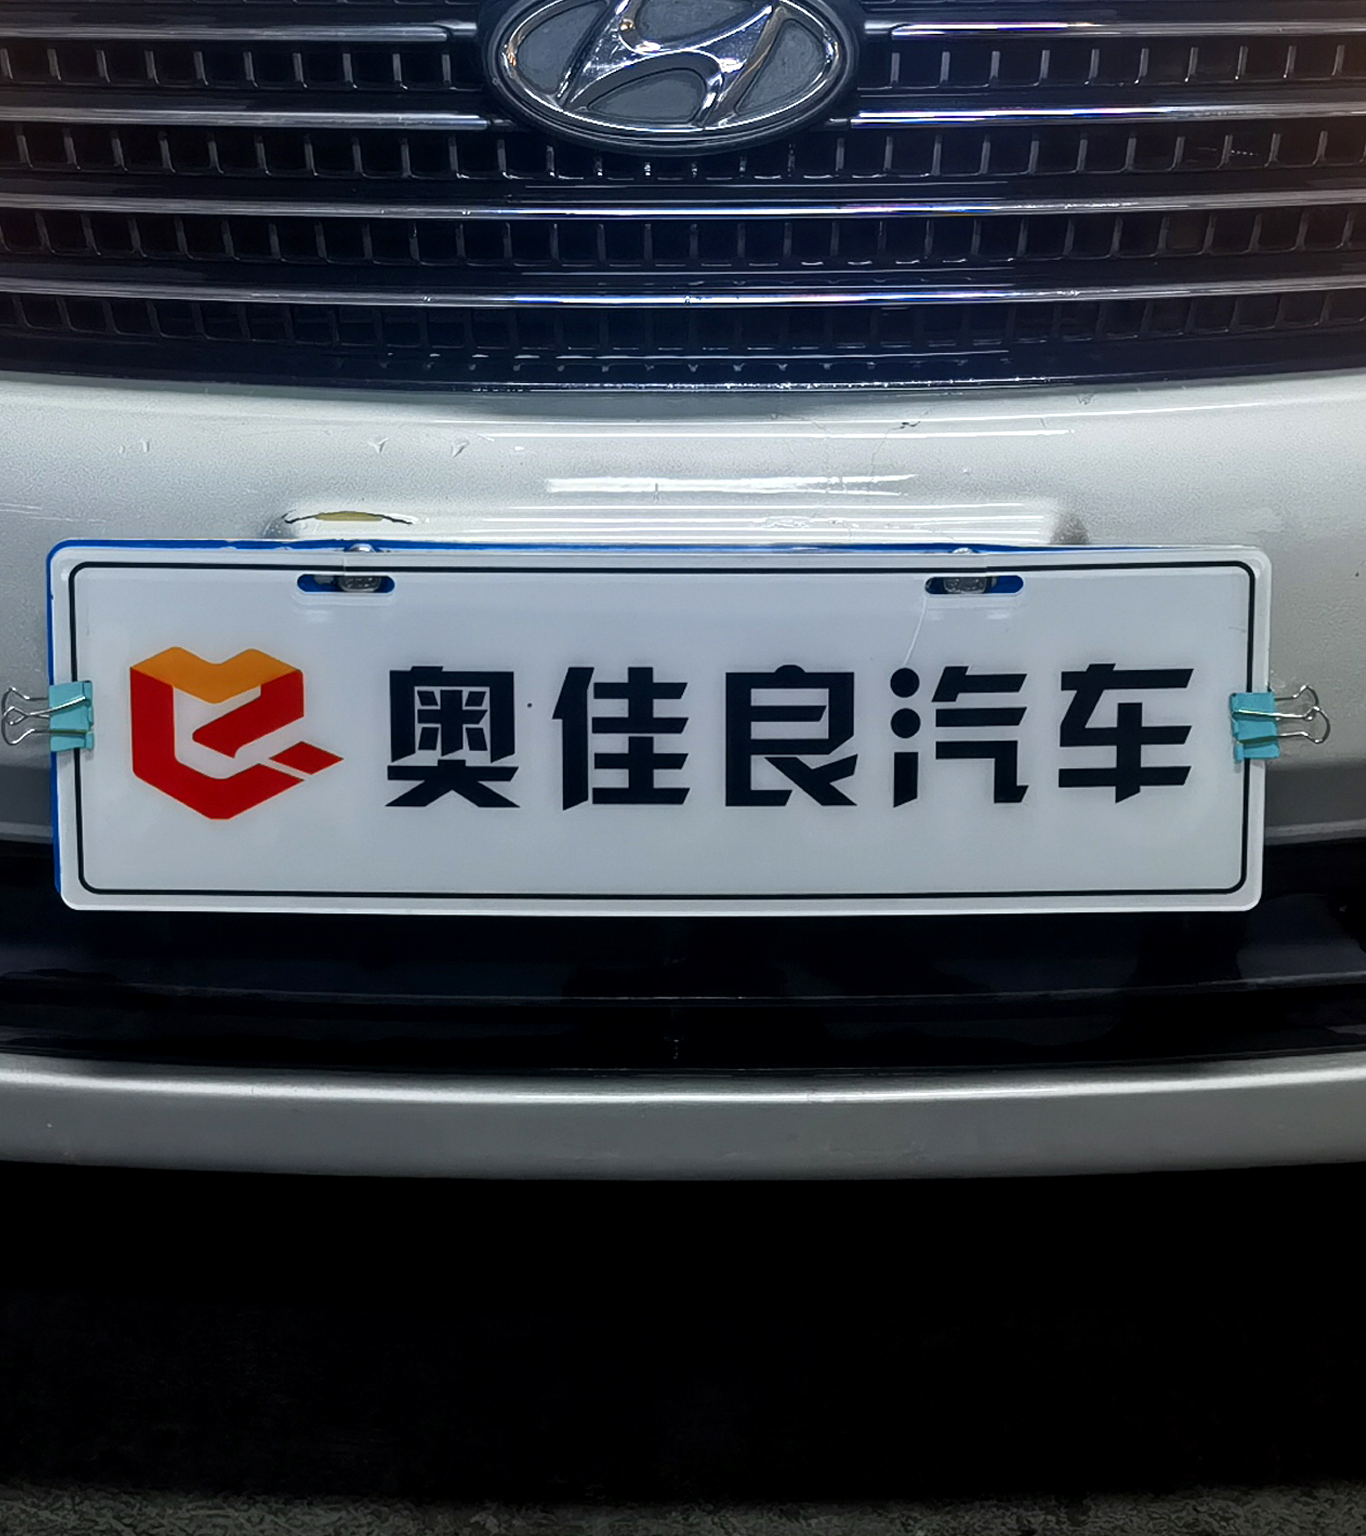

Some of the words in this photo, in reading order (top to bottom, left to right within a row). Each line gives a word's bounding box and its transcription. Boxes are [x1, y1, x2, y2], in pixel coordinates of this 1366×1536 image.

[384, 662, 1194, 810] 奥佳良汽车
